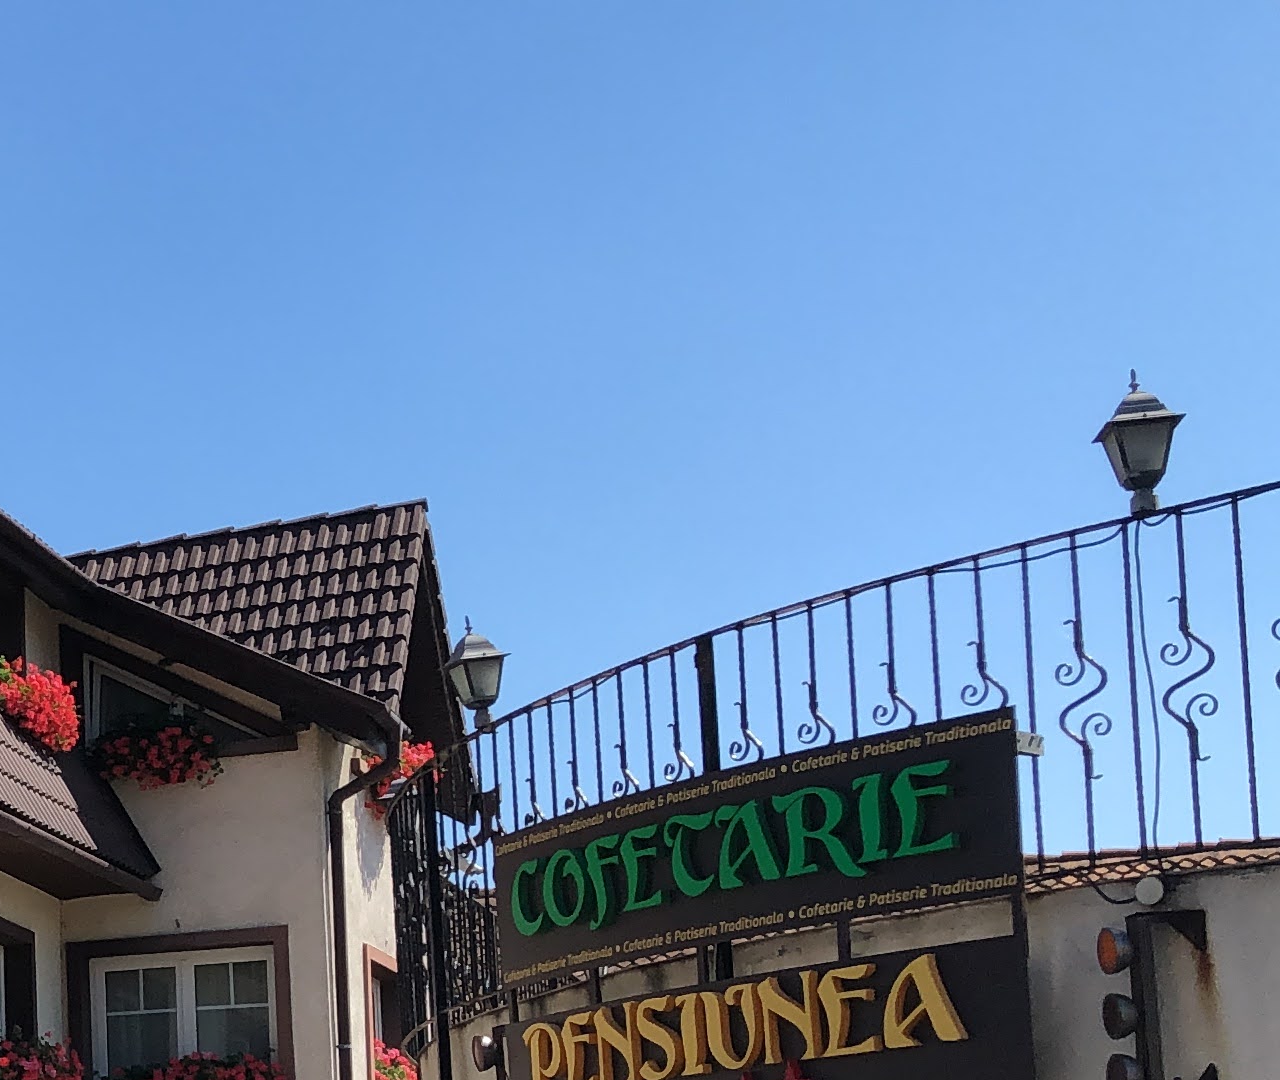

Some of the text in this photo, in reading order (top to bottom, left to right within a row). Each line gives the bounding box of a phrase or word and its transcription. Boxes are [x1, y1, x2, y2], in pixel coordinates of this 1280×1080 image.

[614, 796, 656, 819] Cofetarie
[666, 781, 709, 804] Patiserie
[712, 766, 776, 793] Traditionala
[792, 749, 847, 773] Cofetarie
[850, 747, 859, 761] &
[863, 733, 922, 758] Patiserie
[925, 718, 1012, 745] Traditionala
[511, 760, 961, 938] COFETARIE
[623, 933, 663, 954] Cofetarie
[674, 922, 718, 943] Patiserie
[719, 911, 784, 934] Traditionala
[798, 896, 853, 919] Cofetarie
[857, 895, 865, 909] &
[869, 885, 928, 906] Patiserie
[930, 873, 1018, 897] Traditionala
